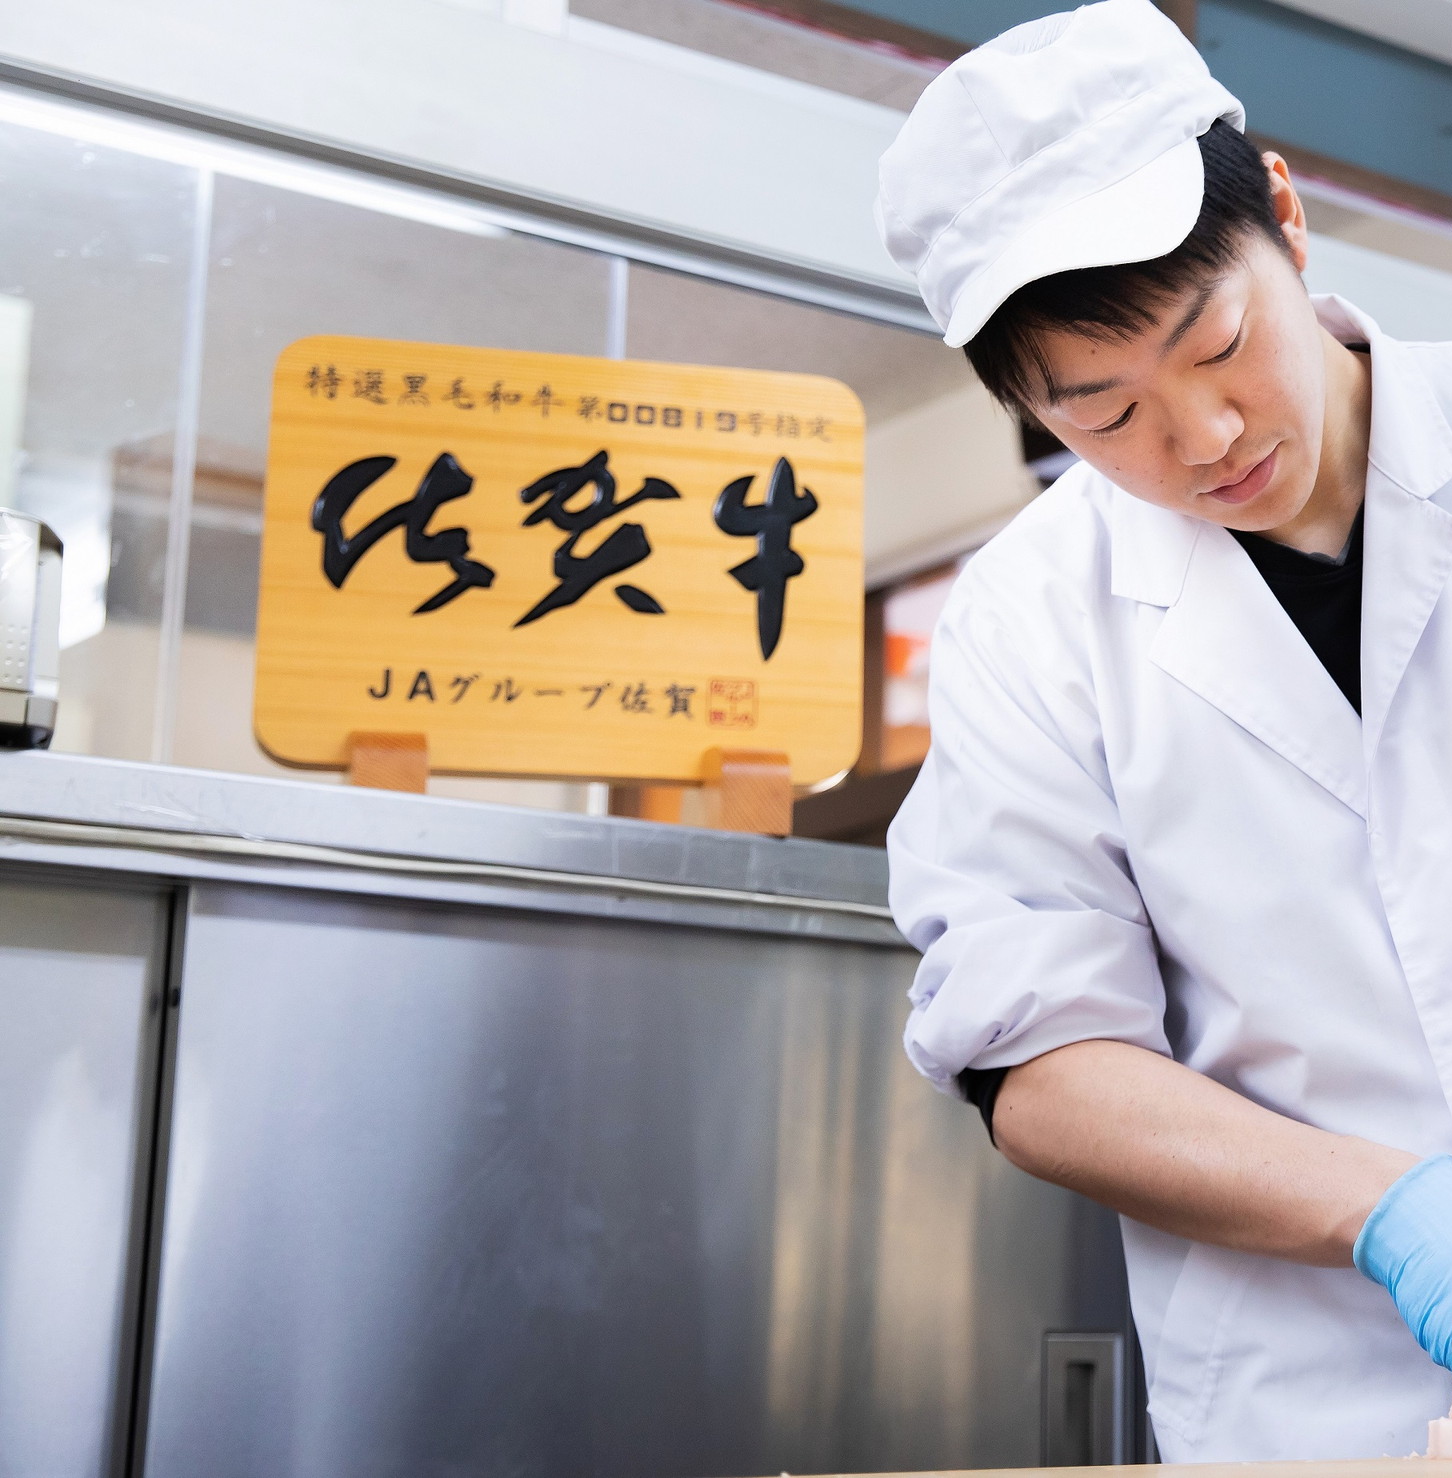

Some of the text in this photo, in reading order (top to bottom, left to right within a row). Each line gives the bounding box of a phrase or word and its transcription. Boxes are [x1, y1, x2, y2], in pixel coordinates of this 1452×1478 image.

[311, 449, 819, 662] 佐賀牛
[367, 668, 697, 720] JAグループ佐賀
